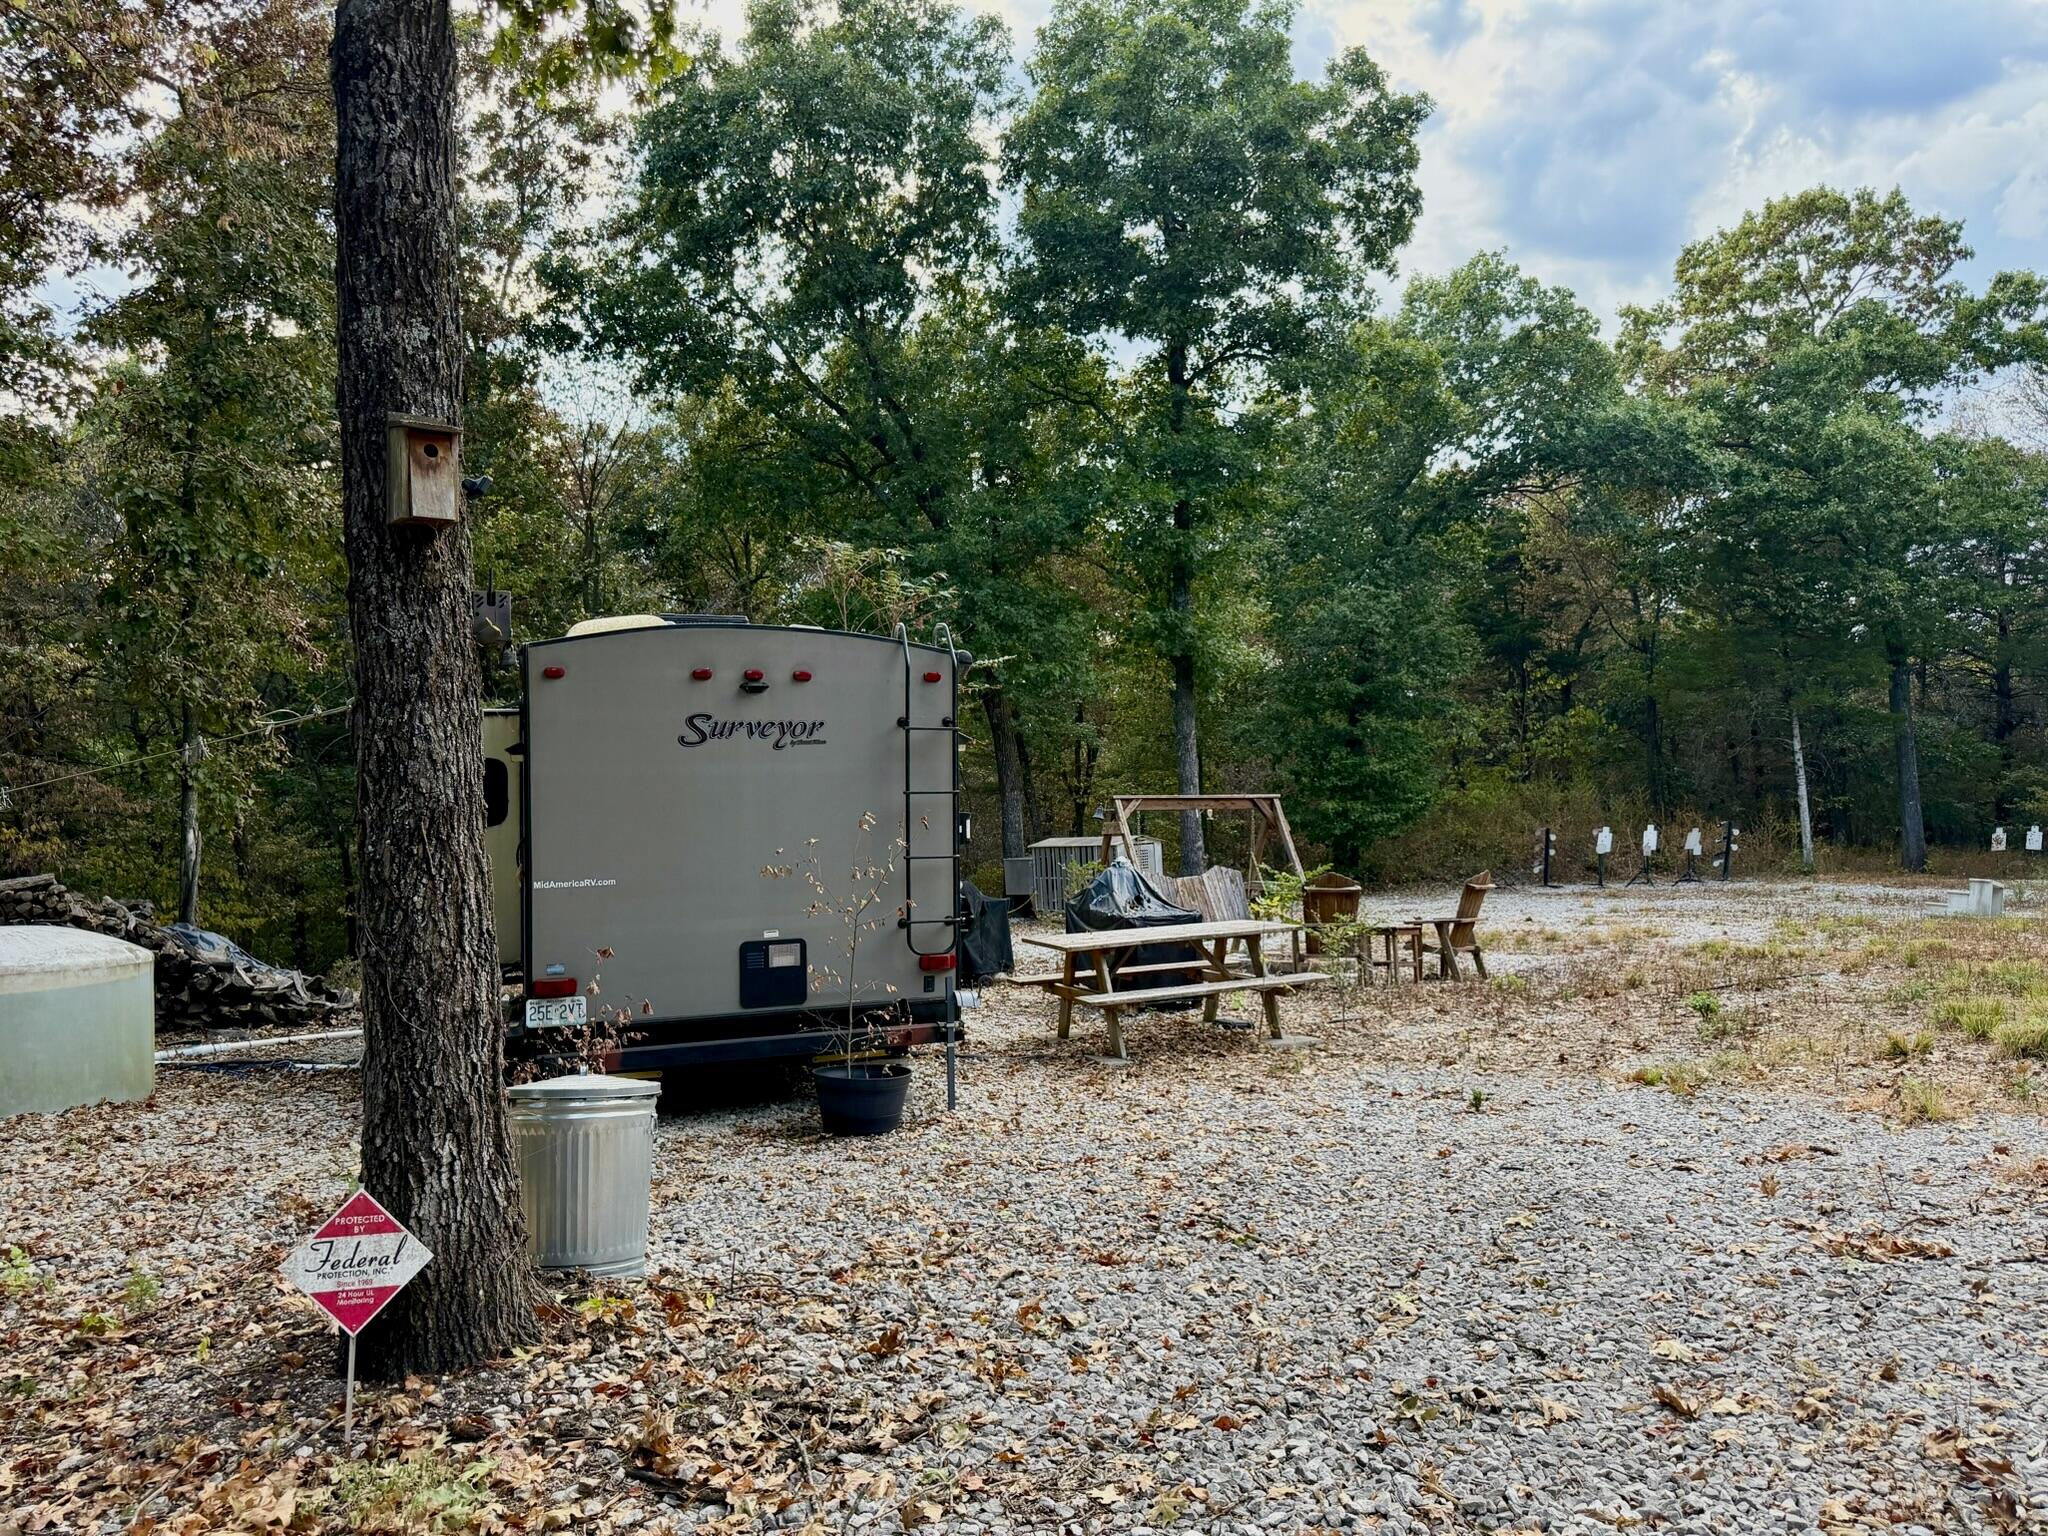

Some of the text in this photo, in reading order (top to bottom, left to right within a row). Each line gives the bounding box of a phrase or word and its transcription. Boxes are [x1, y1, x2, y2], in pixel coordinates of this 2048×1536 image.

[677, 713, 825, 750] Surveyor
[533, 878, 616, 889] MidAmericaRV.com
[529, 1004, 553, 1022] 25E
[334, 1214, 385, 1225] PROTECTED
[354, 1225, 366, 1234] BY
[304, 1234, 408, 1273] Federal
[316, 1268, 370, 1280] PROTECTION,
[336, 1280, 355, 1288] Since
[337, 1289, 375, 1299] 24 Hour UL
[336, 1297, 375, 1306] Monitoring
